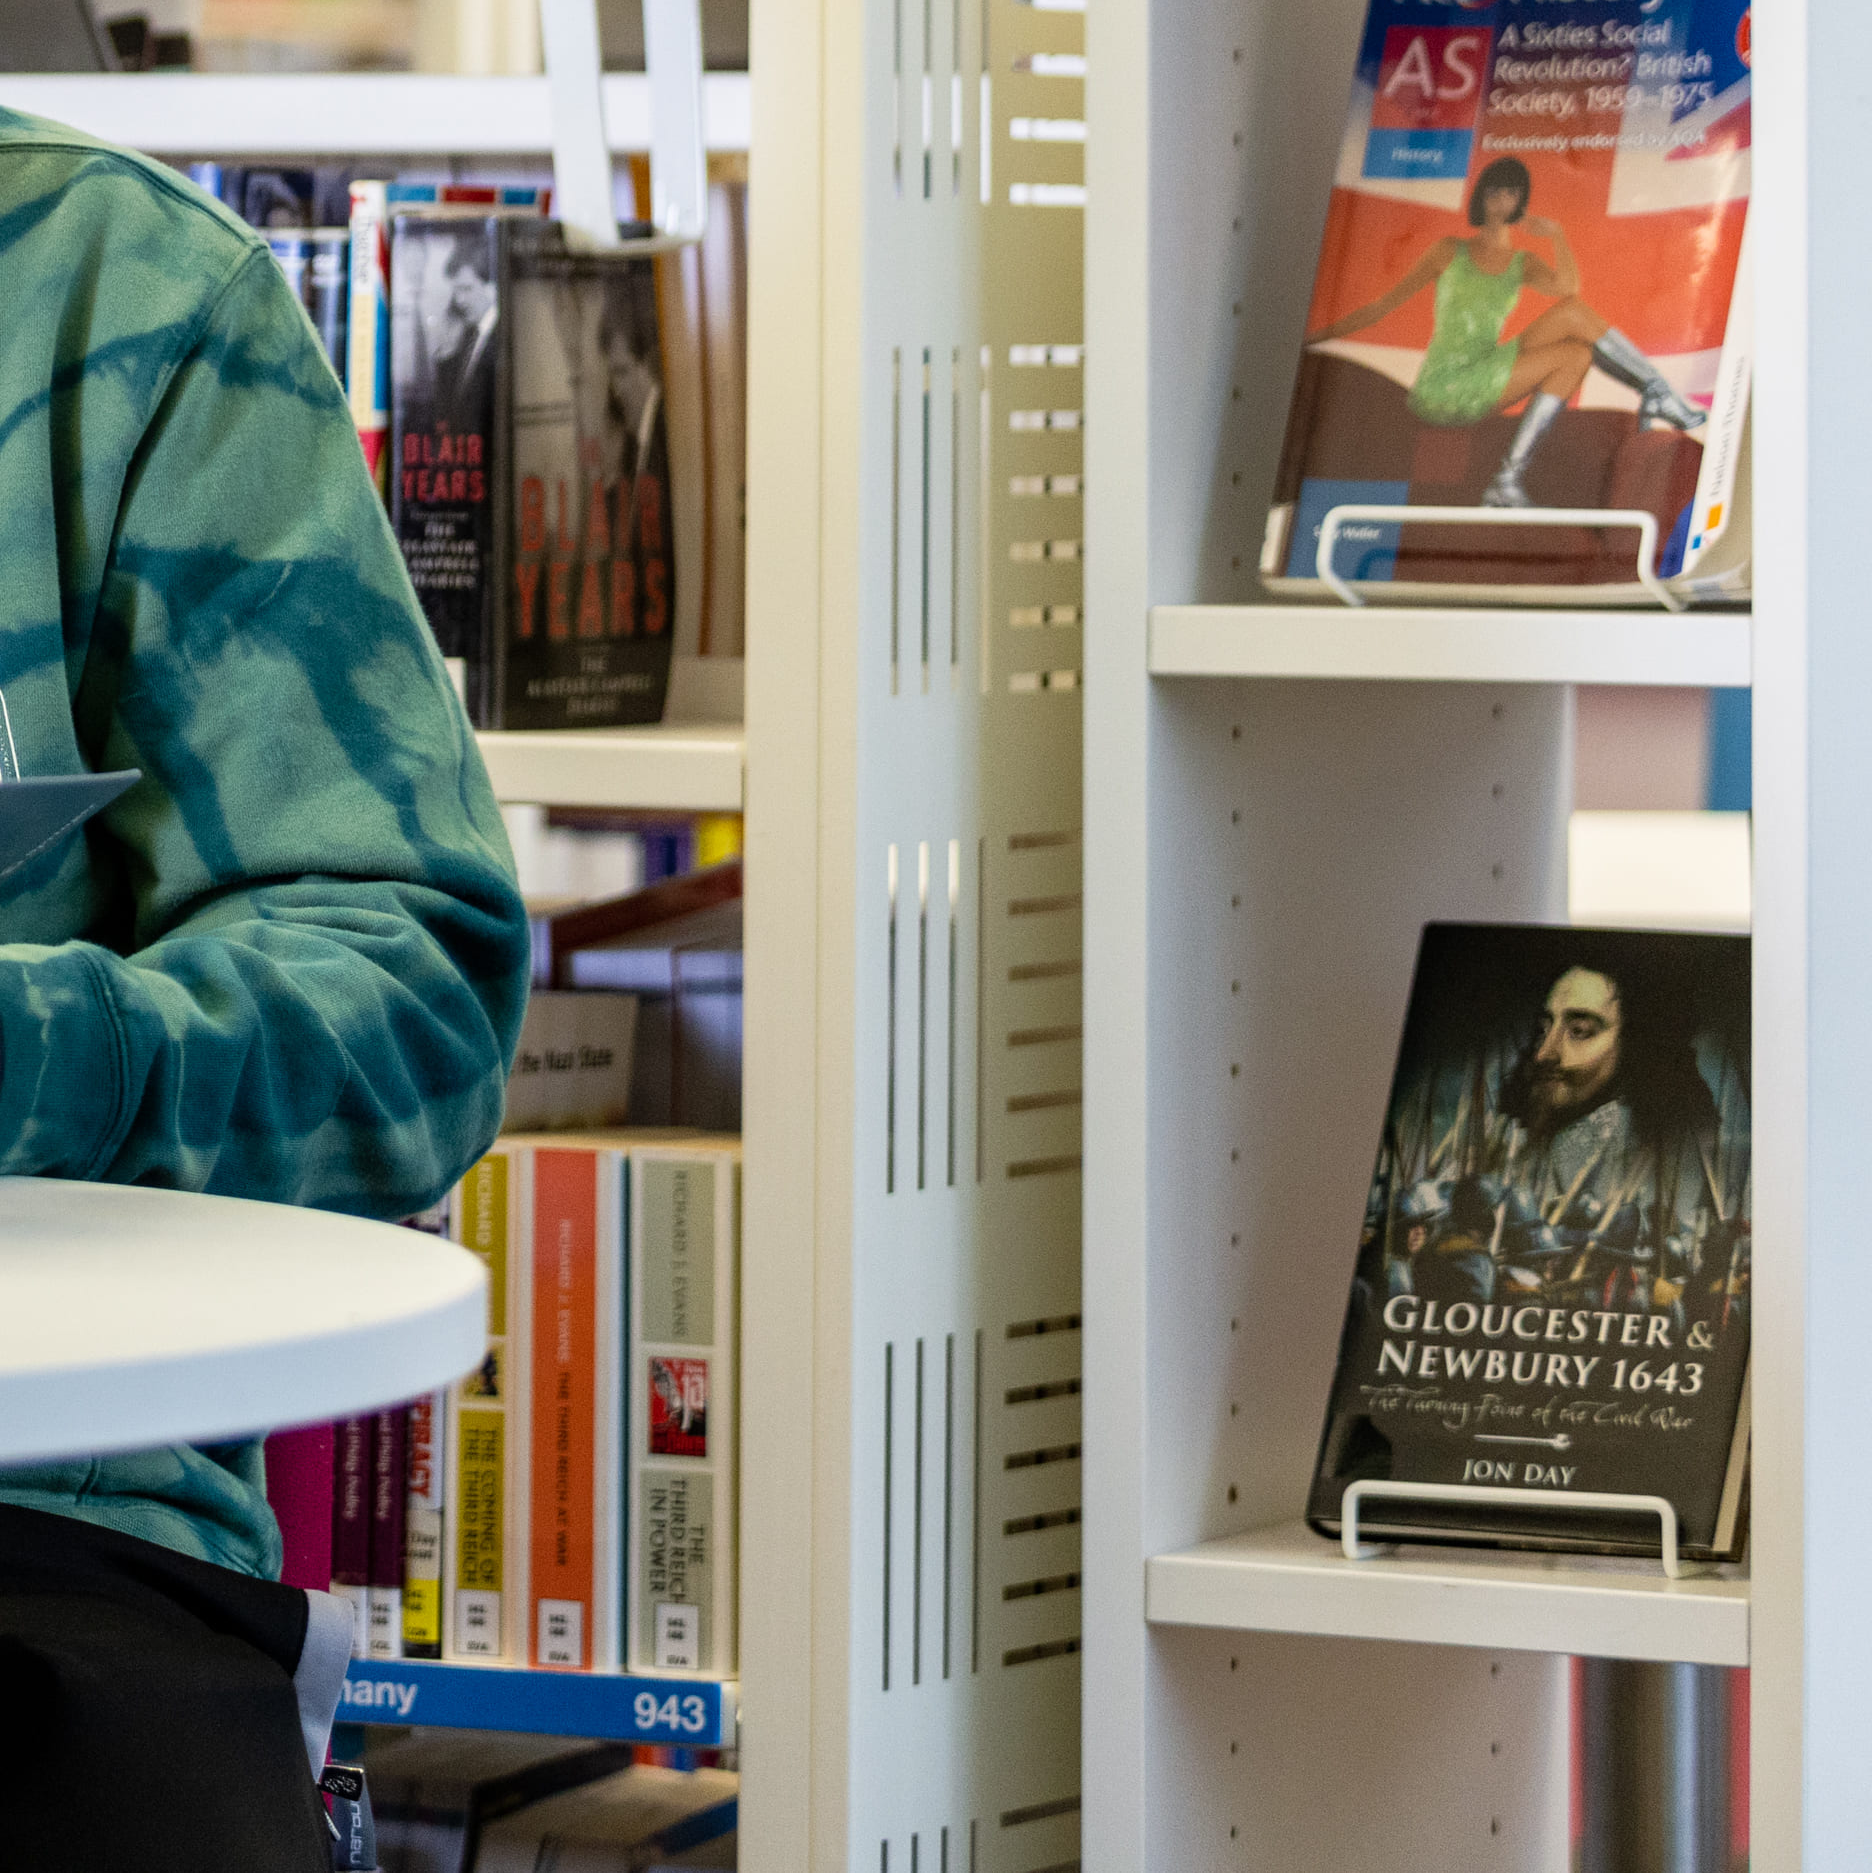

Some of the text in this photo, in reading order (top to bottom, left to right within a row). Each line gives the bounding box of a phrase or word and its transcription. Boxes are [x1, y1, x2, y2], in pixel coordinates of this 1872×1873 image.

[1497, 18, 1672, 49] A Sixties Social
[1382, 35, 1480, 100] AS
[1492, 47, 1713, 82] Revolution? British
[1487, 85, 1577, 119] Society,
[402, 432, 483, 466] BLAIR
[402, 469, 487, 503] YEARS
[520, 475, 663, 553] BLAIR
[515, 559, 667, 642] YEARS
[1382, 1293, 1715, 1351] GLOUCESTER &
[1375, 1338, 1706, 1397] NEWBURY 1643
[1462, 1458, 1578, 1486] JON DAY
[632, 1692, 707, 1731] 943
